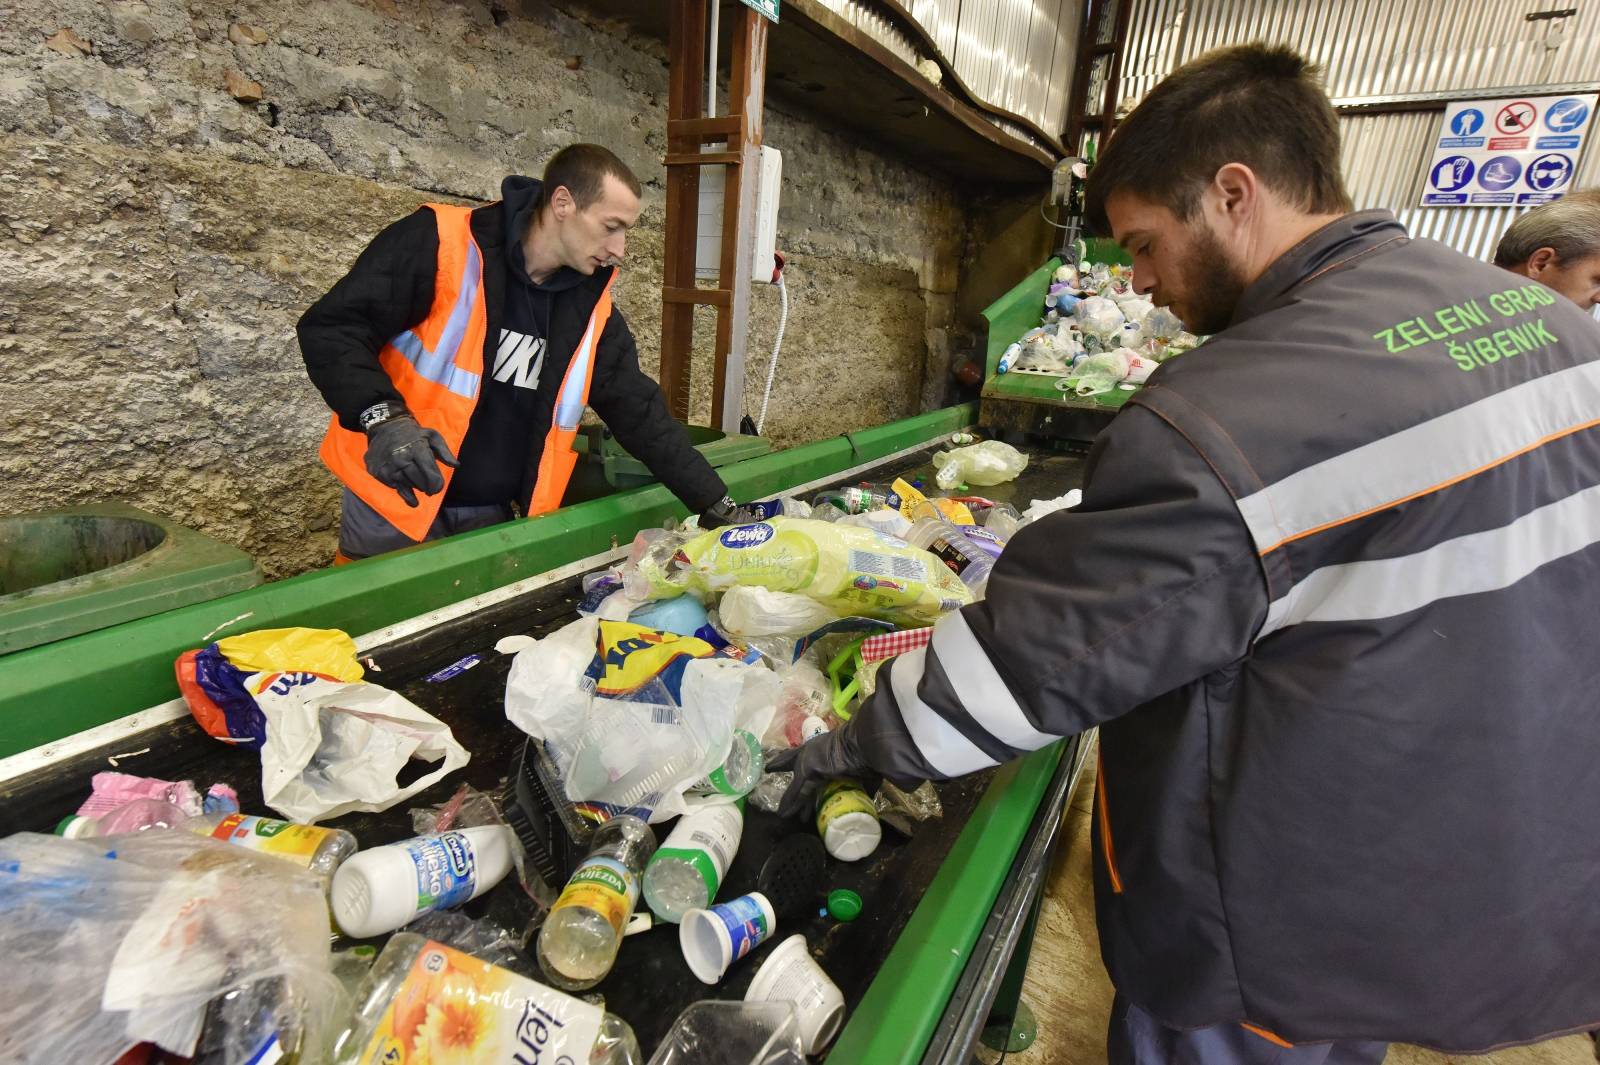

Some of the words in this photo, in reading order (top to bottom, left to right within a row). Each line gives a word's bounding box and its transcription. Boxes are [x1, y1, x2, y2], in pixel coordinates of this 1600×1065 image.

[1373, 299, 1491, 353] ZELENI
[1489, 285, 1556, 317] GRAD
[1445, 318, 1559, 372] ŠIBENIK
[728, 526, 768, 543] Zewa
[447, 837, 465, 870] Dukat
